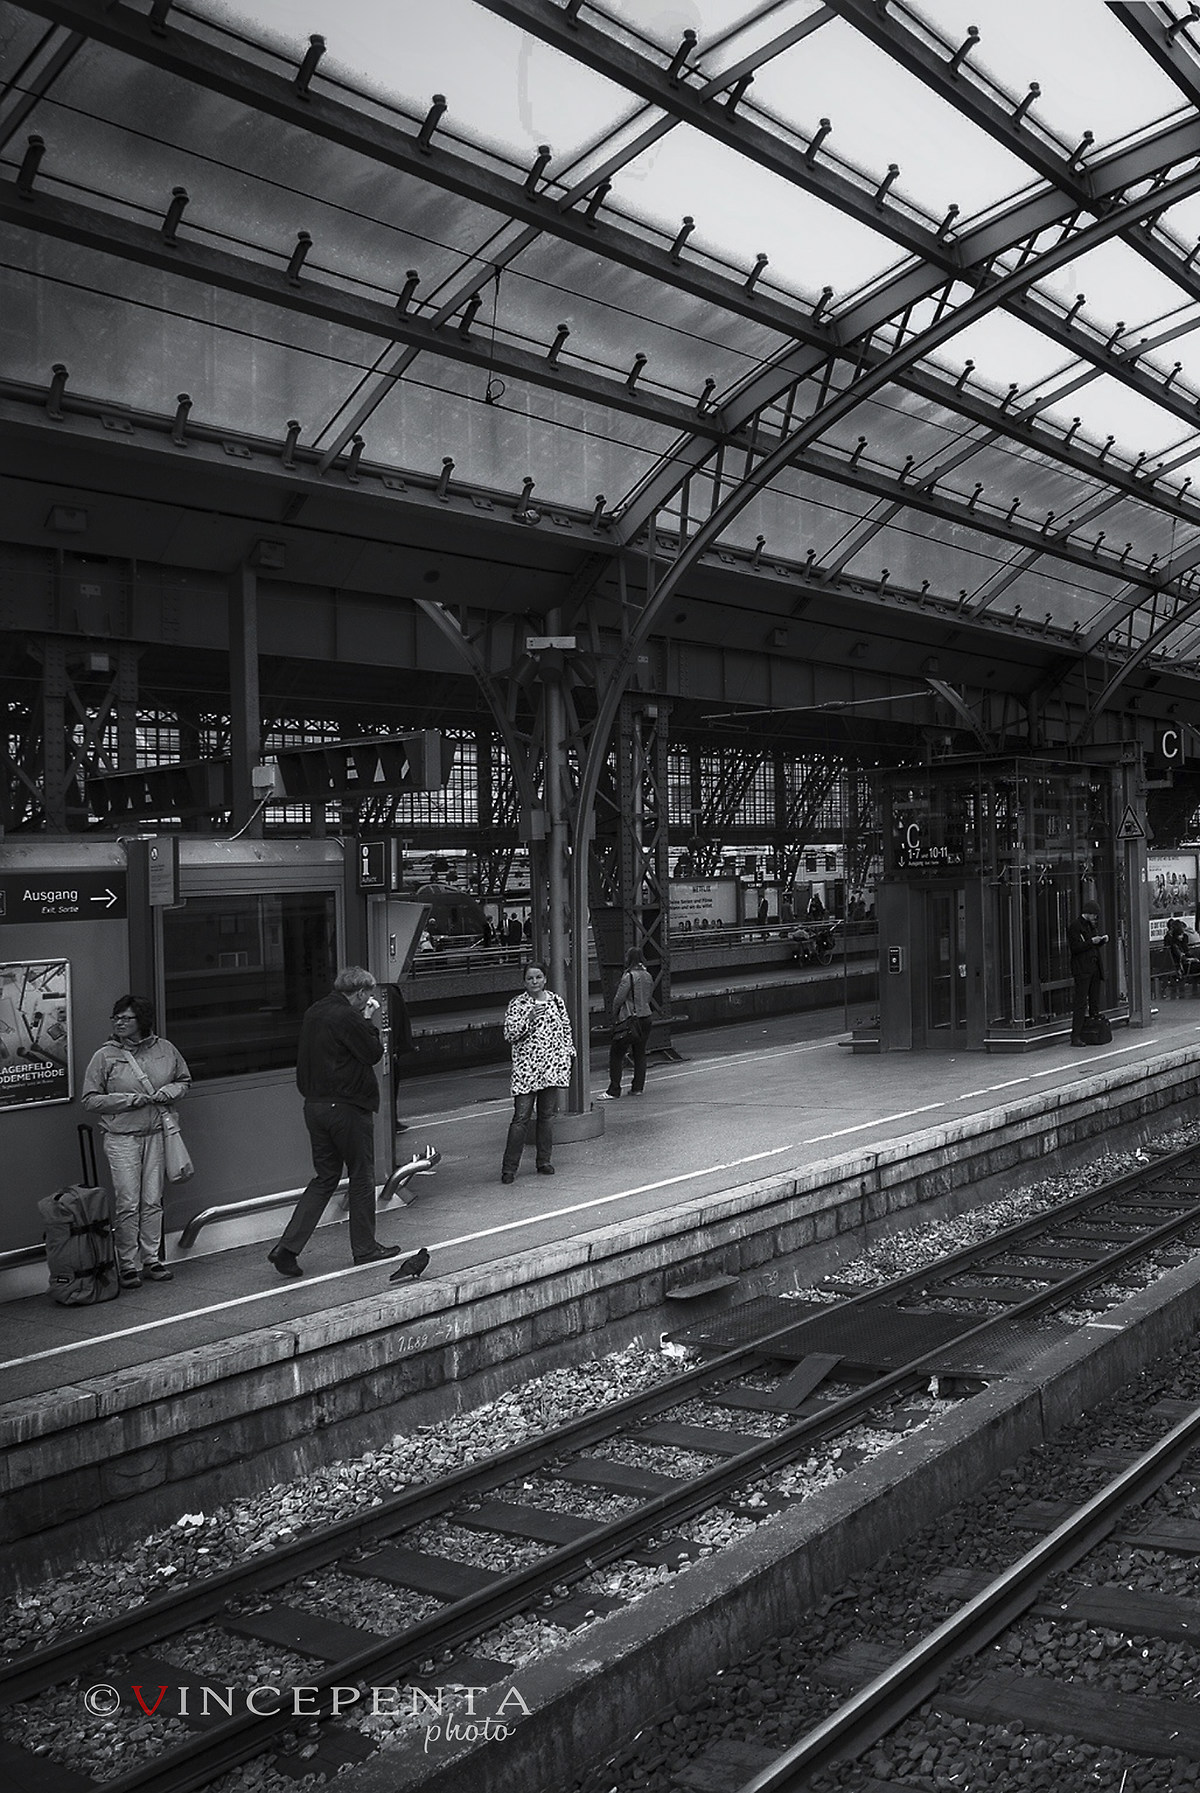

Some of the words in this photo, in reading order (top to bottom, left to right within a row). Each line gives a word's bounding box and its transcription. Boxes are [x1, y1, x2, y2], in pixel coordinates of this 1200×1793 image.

[1161, 729, 1179, 760] C
[906, 823, 920, 849] C
[907, 848, 921, 860] 1-7
[929, 846, 948, 859] 10-11
[22, 889, 79, 903] Ausgang
[58, 905, 80, 914] Sortie
